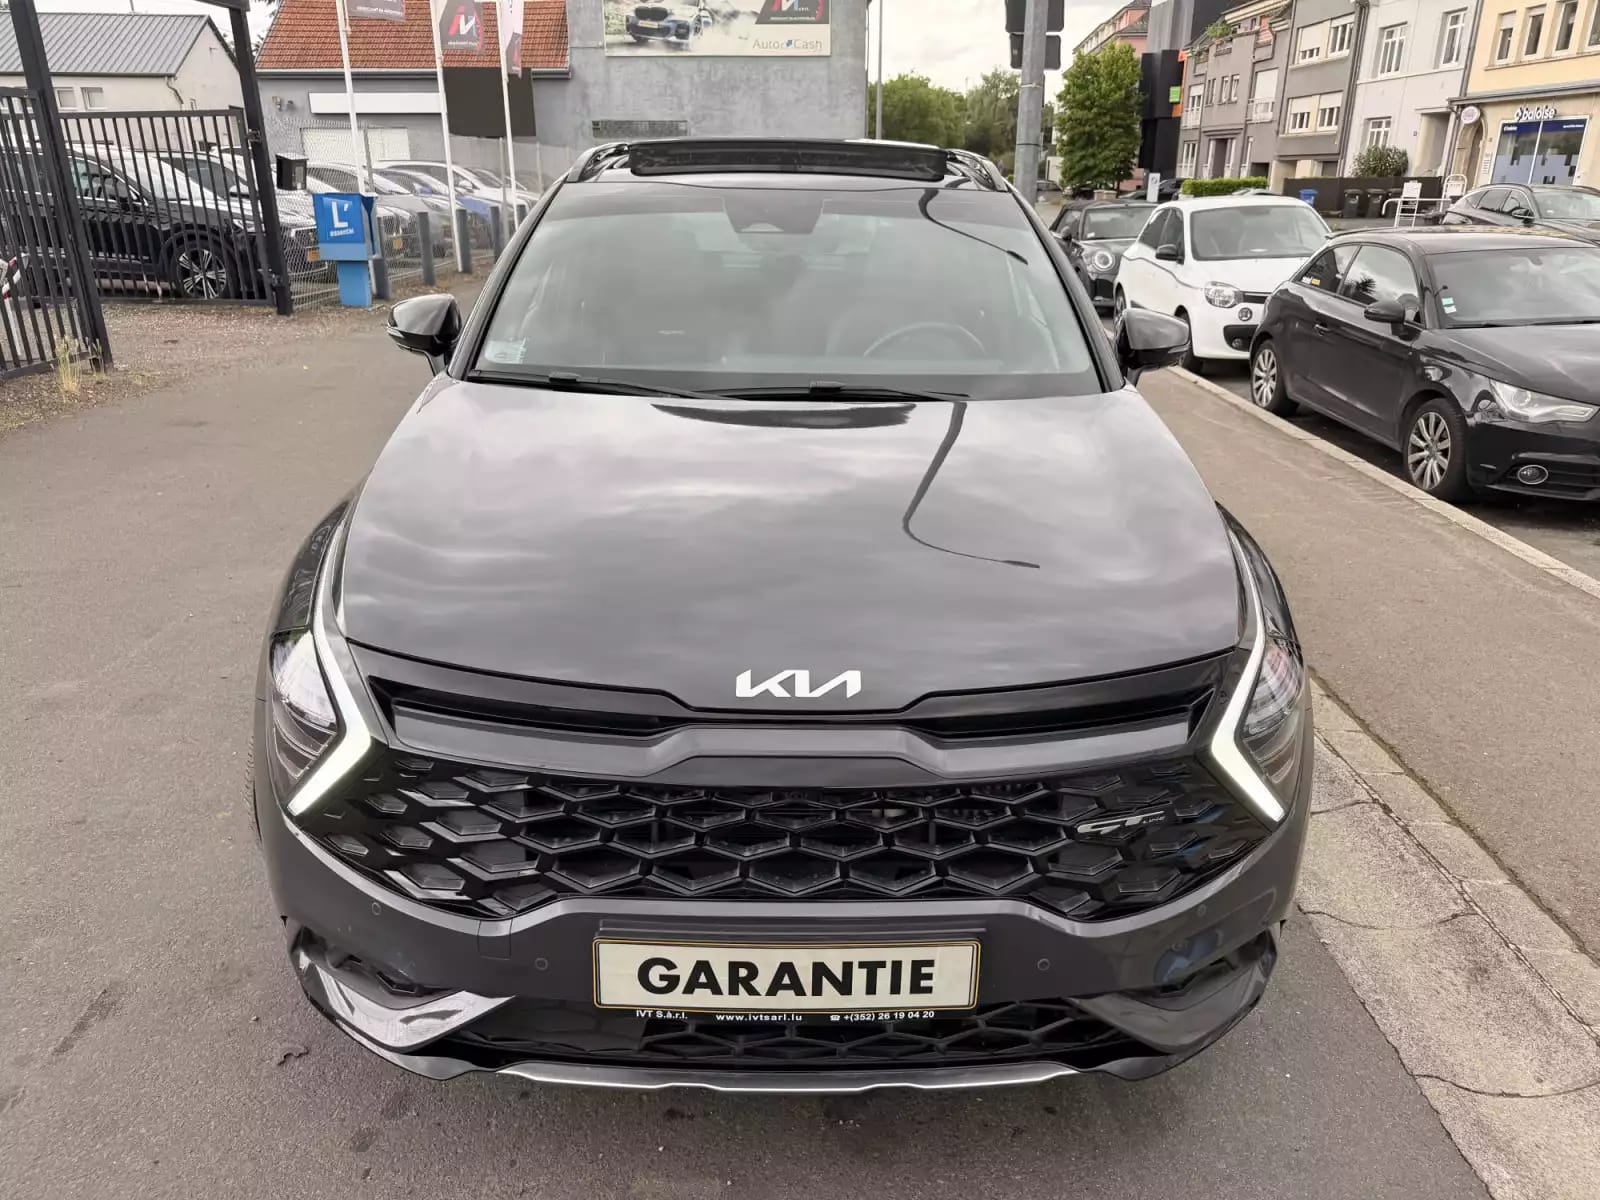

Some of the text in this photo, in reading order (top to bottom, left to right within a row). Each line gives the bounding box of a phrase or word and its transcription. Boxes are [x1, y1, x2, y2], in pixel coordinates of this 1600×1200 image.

[735, 669, 862, 699] KIA
[637, 957, 935, 997] GARANTIE
[635, 1009, 653, 1018] IVT
[715, 1013, 803, 1021] www.ivtsarl.lu
[843, 1012, 876, 1021] +(352)
[907, 1011, 920, 1019] 04
[922, 1010, 935, 1018] 20
